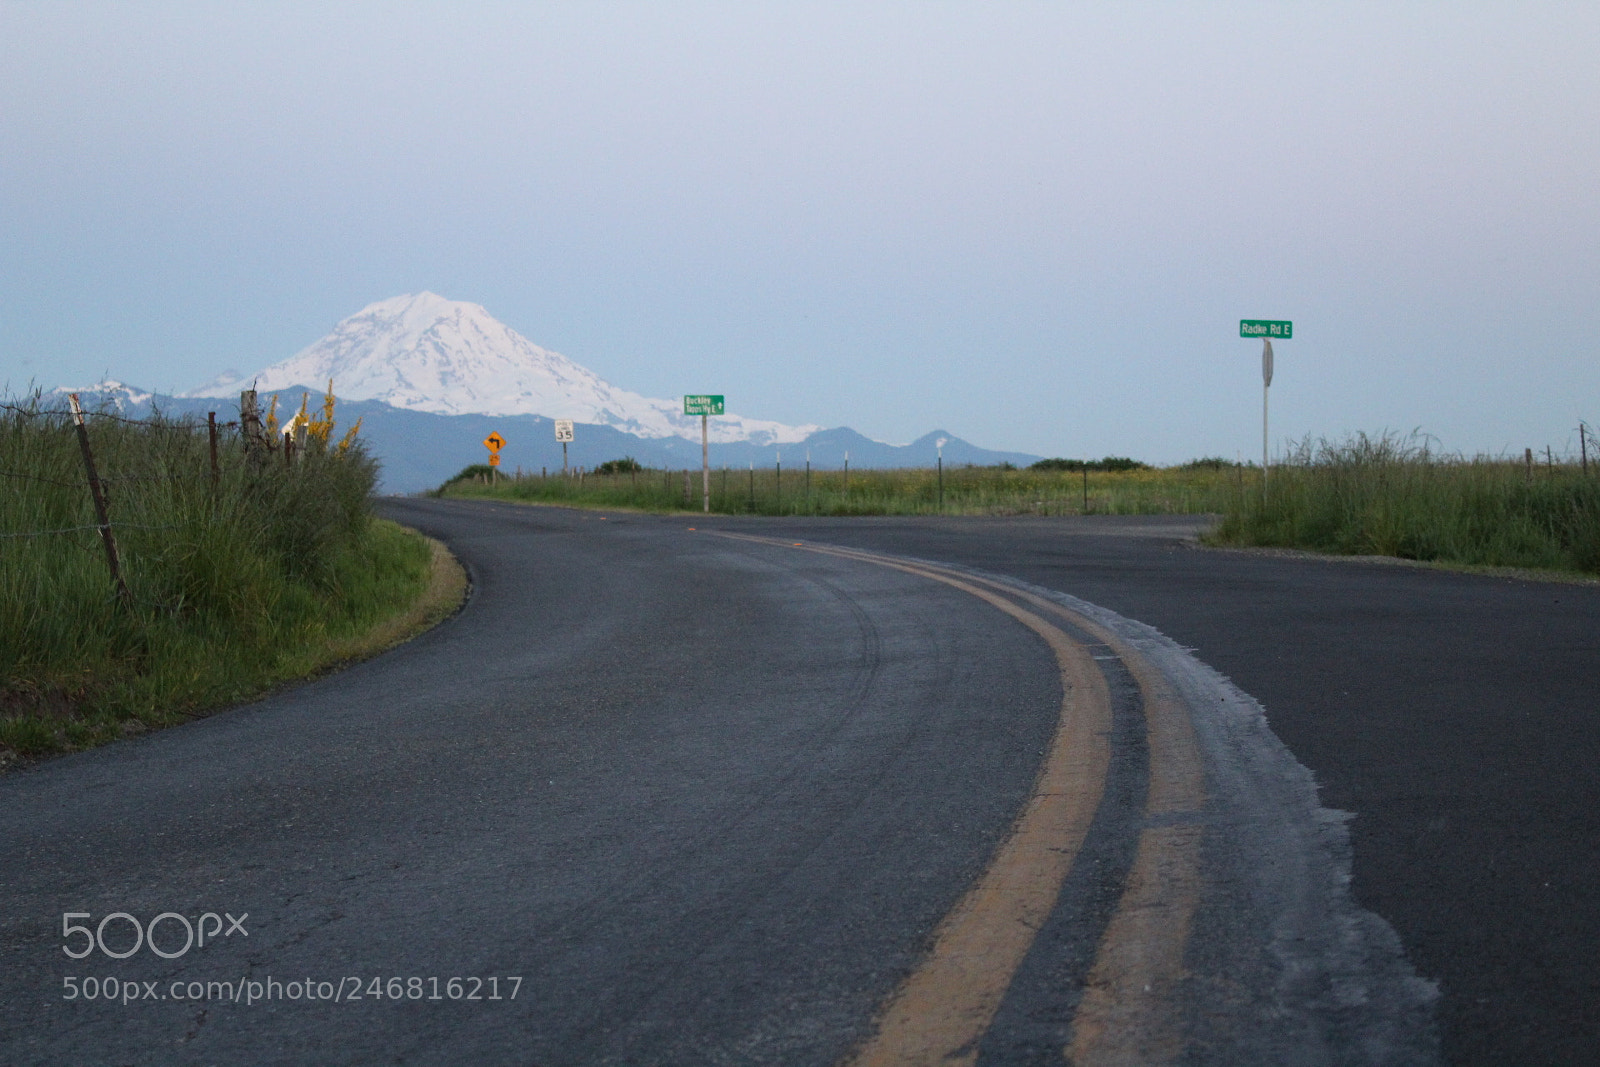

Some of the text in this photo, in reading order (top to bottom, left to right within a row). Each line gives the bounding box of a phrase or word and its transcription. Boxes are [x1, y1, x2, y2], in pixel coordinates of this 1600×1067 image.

[1241, 323, 1290, 335] Radke Rd E
[686, 396, 711, 405] Buckley
[711, 404, 716, 413] E
[556, 431, 573, 440] 35
